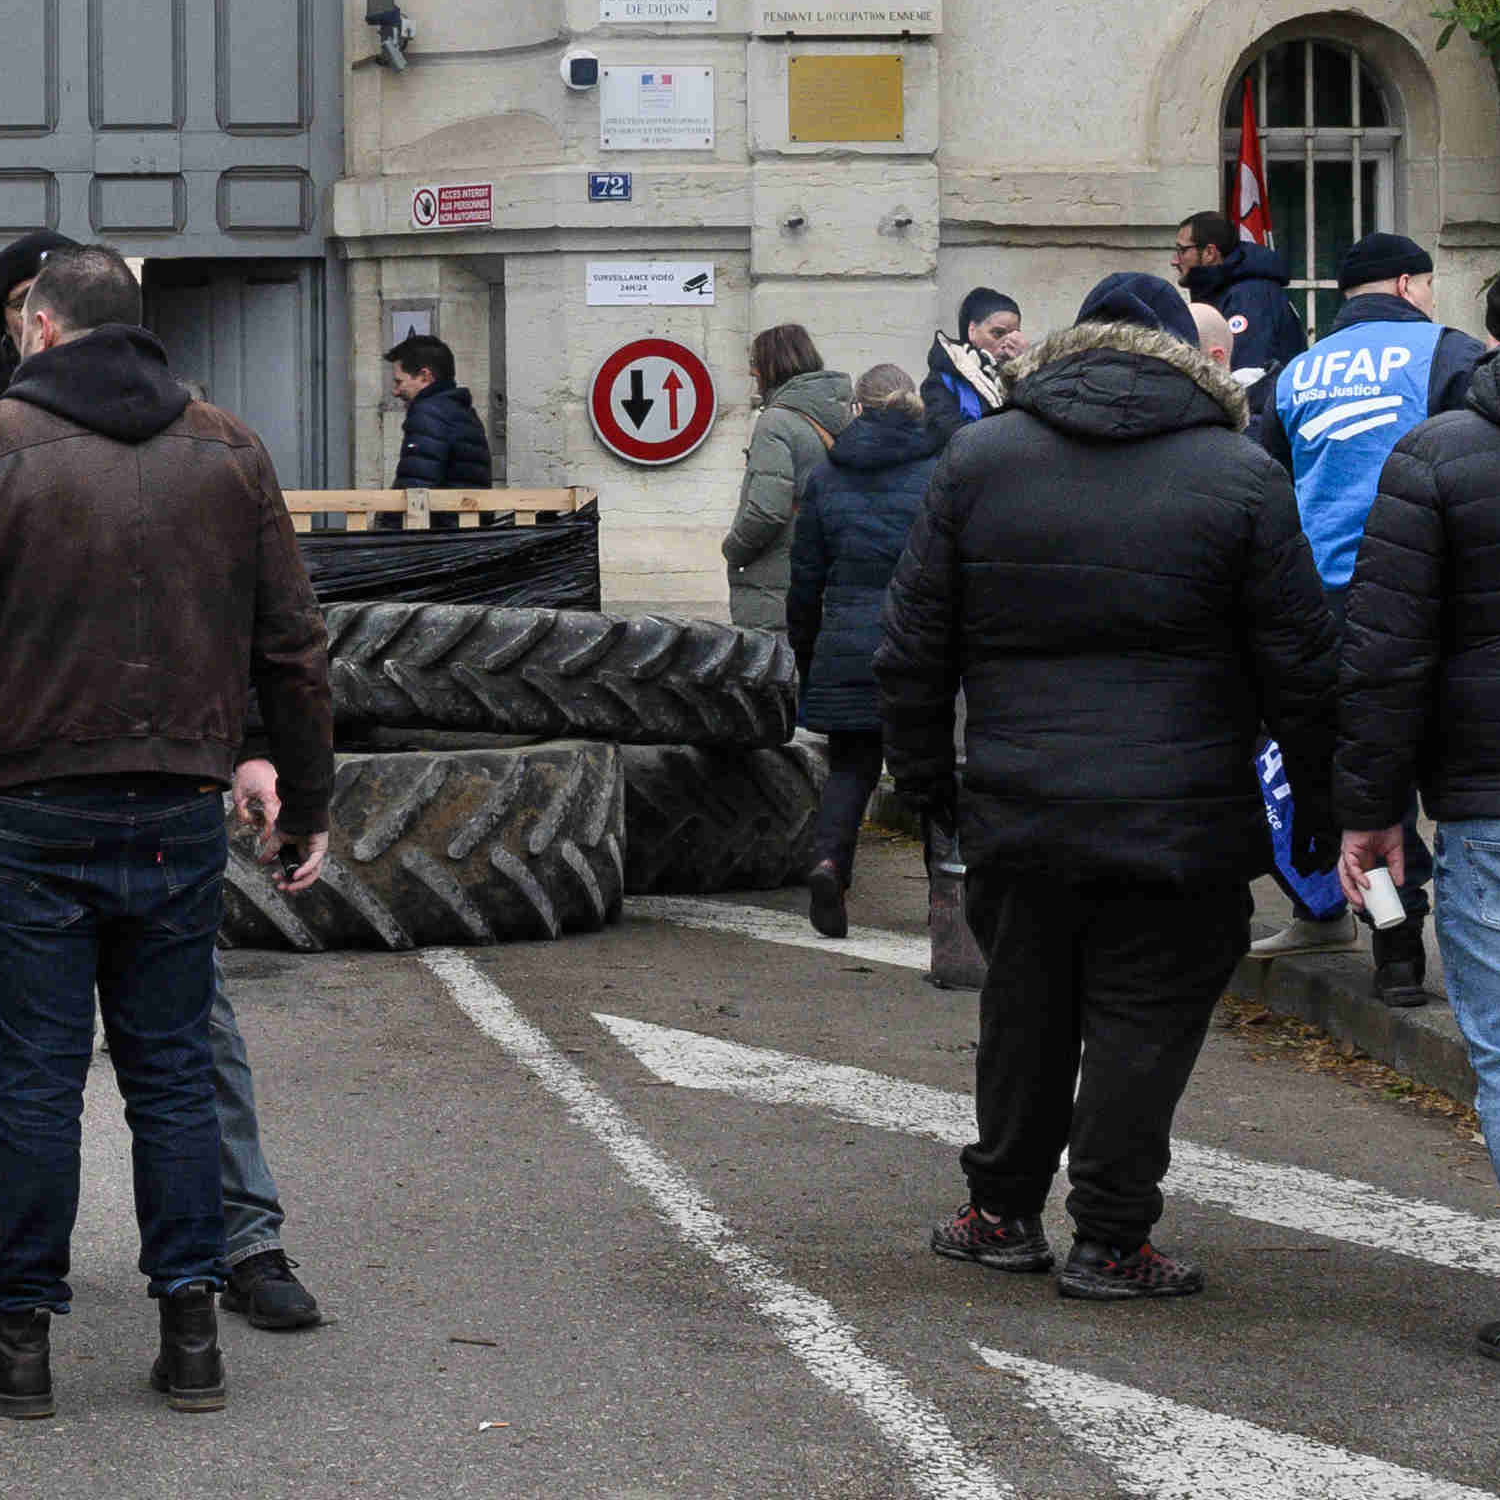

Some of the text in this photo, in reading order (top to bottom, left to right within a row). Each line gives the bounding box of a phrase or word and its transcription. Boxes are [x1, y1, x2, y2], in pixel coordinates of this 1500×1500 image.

[626, 3, 690, 16] DE DIJON
[763, 11, 812, 21] PENDANT
[889, 11, 932, 20] ENNEMIE
[596, 176, 624, 195] 72
[593, 273, 648, 282] SURVEILLANCE
[1292, 346, 1411, 391] UFAP
[1329, 384, 1382, 398] Justice
